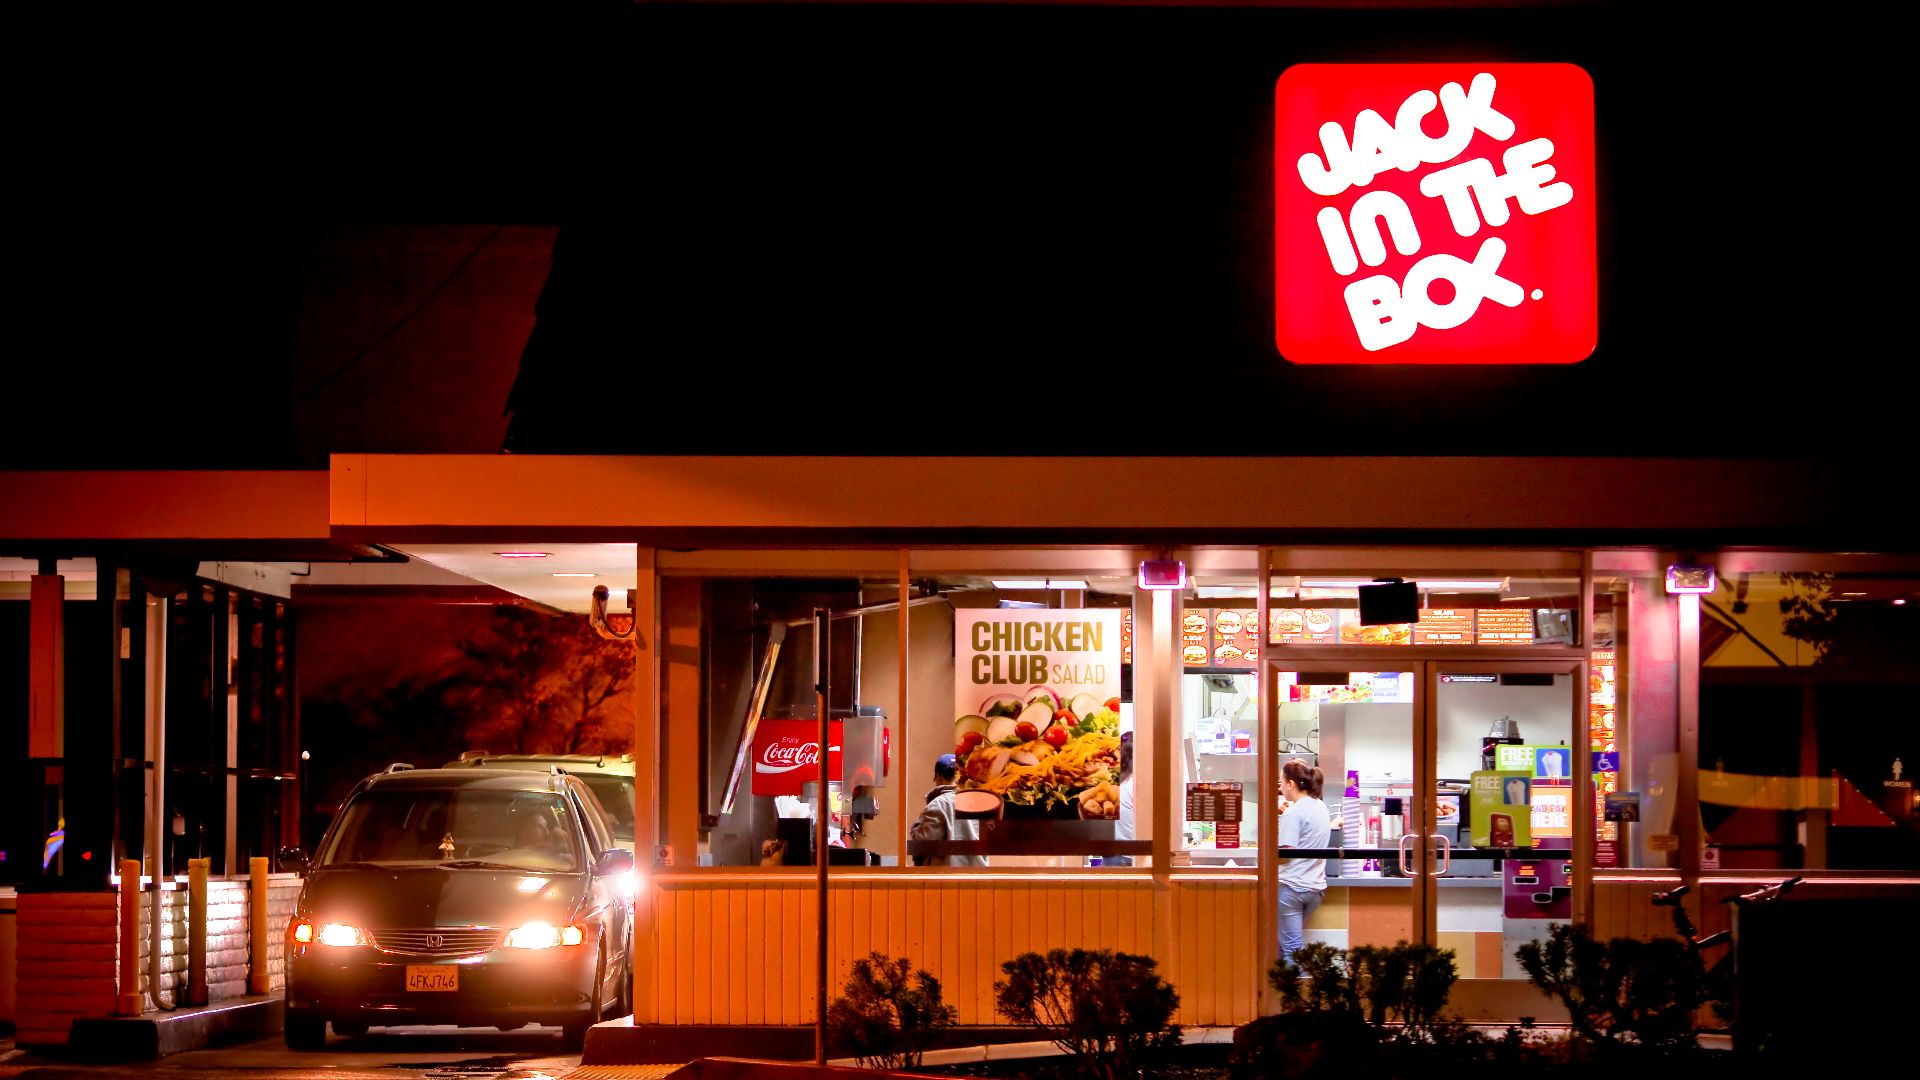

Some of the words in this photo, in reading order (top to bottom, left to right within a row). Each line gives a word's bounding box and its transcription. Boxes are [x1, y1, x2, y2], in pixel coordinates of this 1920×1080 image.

[1297, 72, 1515, 196] JACK
[1419, 137, 1574, 237] THE
[972, 621, 1103, 652] CHICKEN
[972, 654, 1048, 685] CLUB
[1052, 664, 1105, 685] SALAD
[782, 736, 800, 744] Enjoy
[1501, 747, 1534, 760] FREE
[1475, 776, 1501, 790] FREE
[1884, 780, 1911, 788] WOMEN
[1532, 813, 1568, 828] HERE
[410, 975, 455, 988] 4FKJ746
